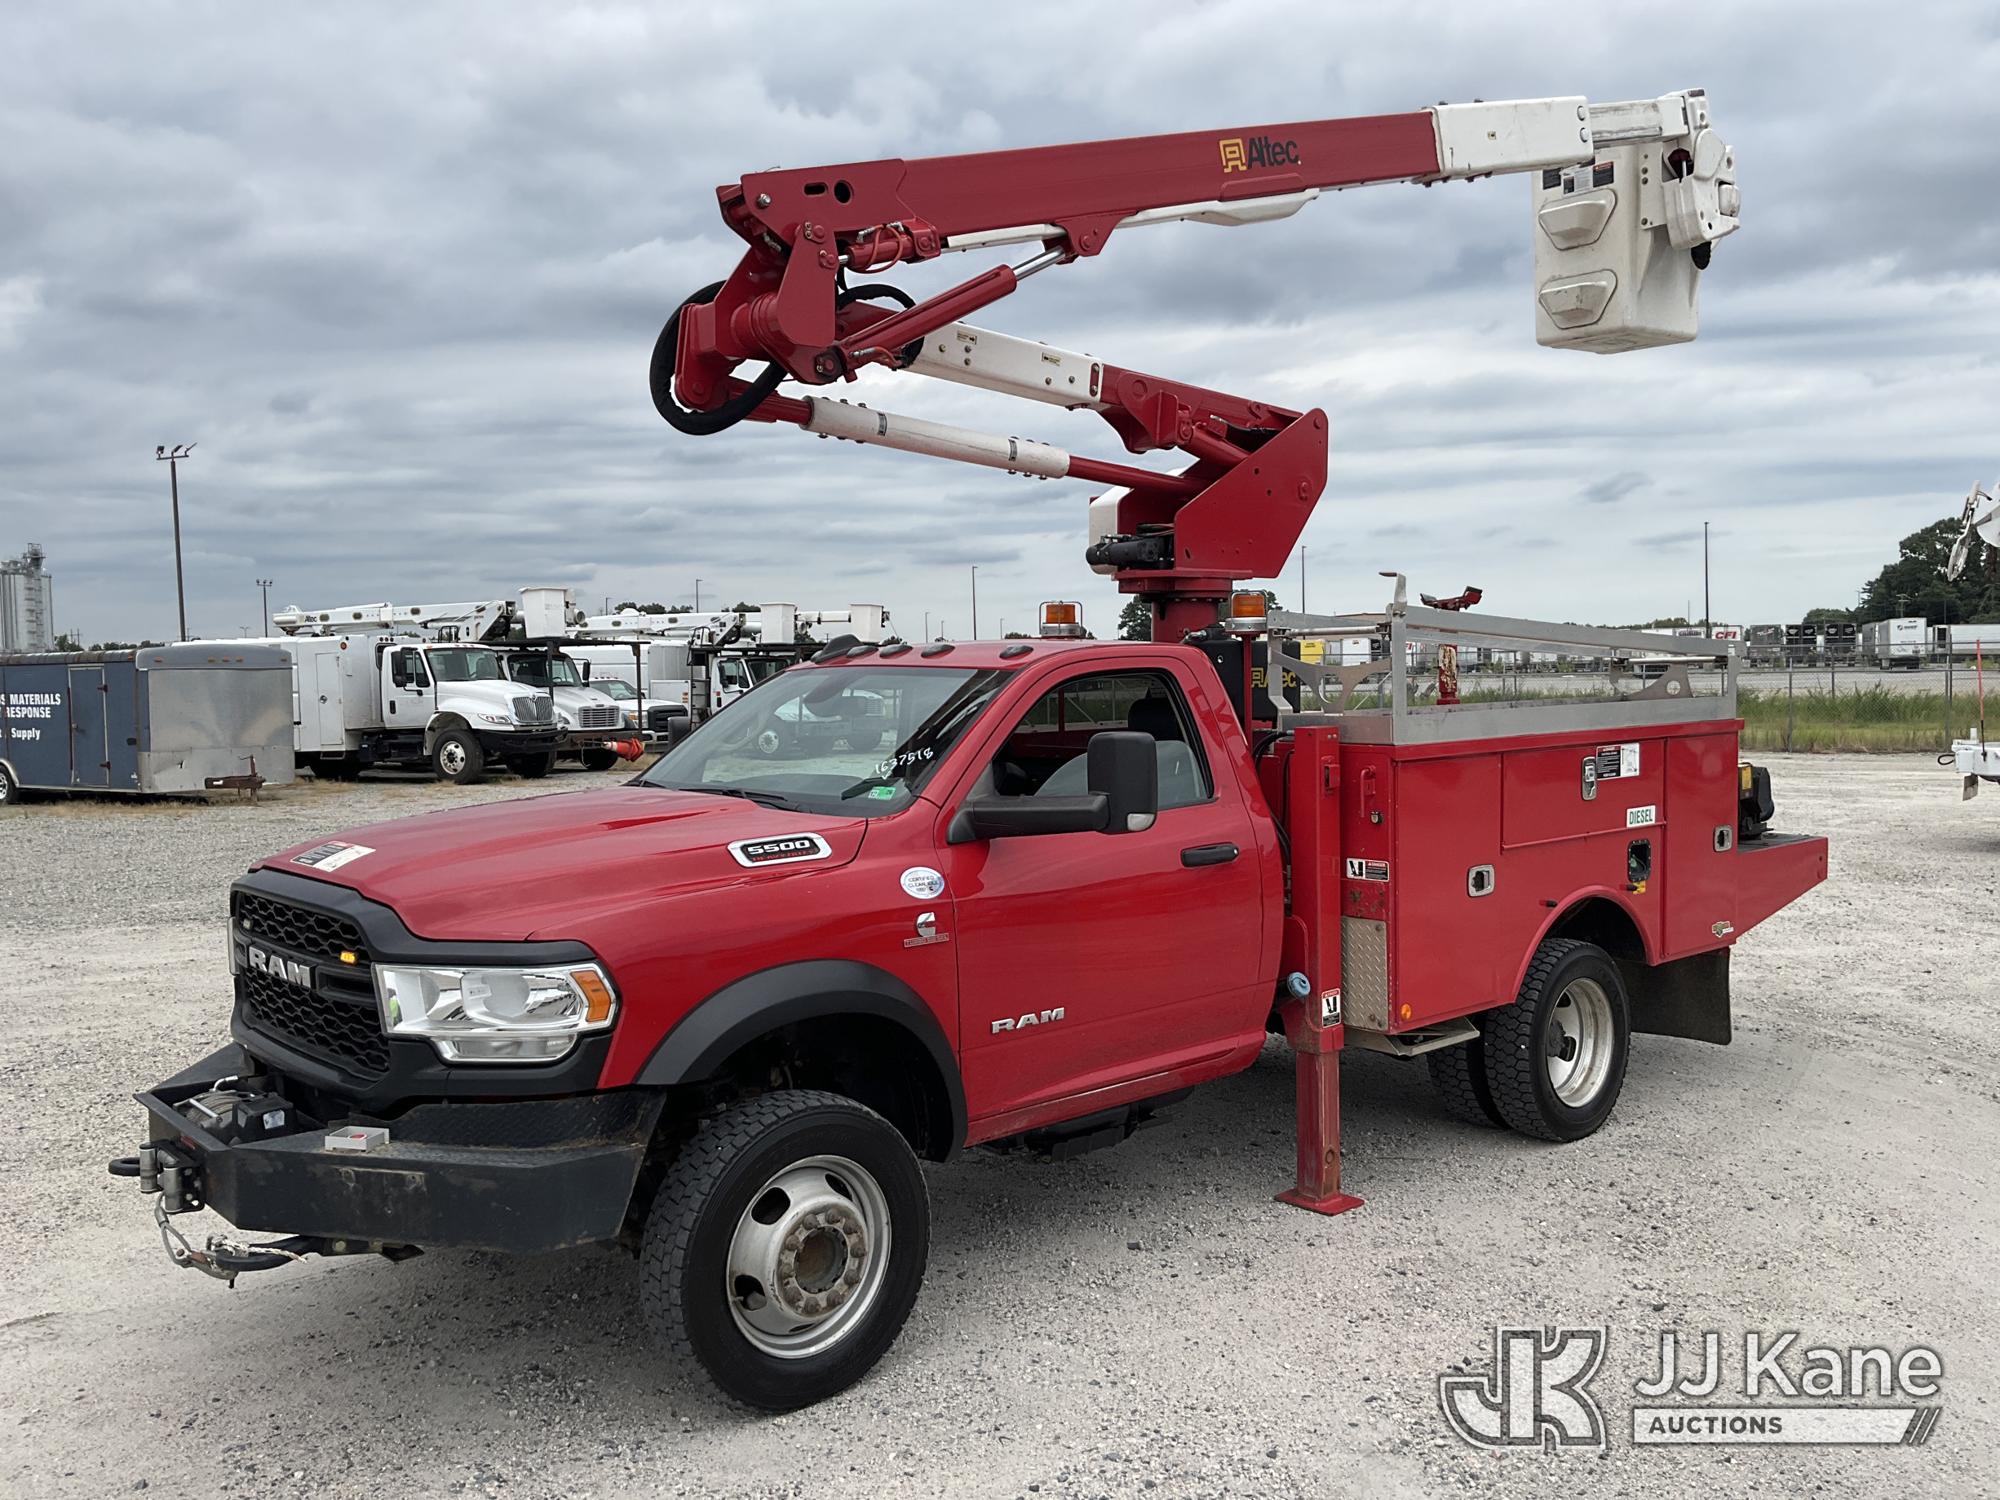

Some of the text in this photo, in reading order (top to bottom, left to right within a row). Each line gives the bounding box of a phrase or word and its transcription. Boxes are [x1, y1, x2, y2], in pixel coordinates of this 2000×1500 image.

[1247, 136, 1300, 169] Altec
[1715, 631, 1737, 640] CFI
[9, 693, 61, 705] MATERIALS
[11, 727, 40, 741] Supply
[1629, 808, 1653, 825] DIESEL
[747, 840, 811, 855] 5500
[248, 945, 312, 989] RAM
[992, 1007, 1065, 1033] RAM
